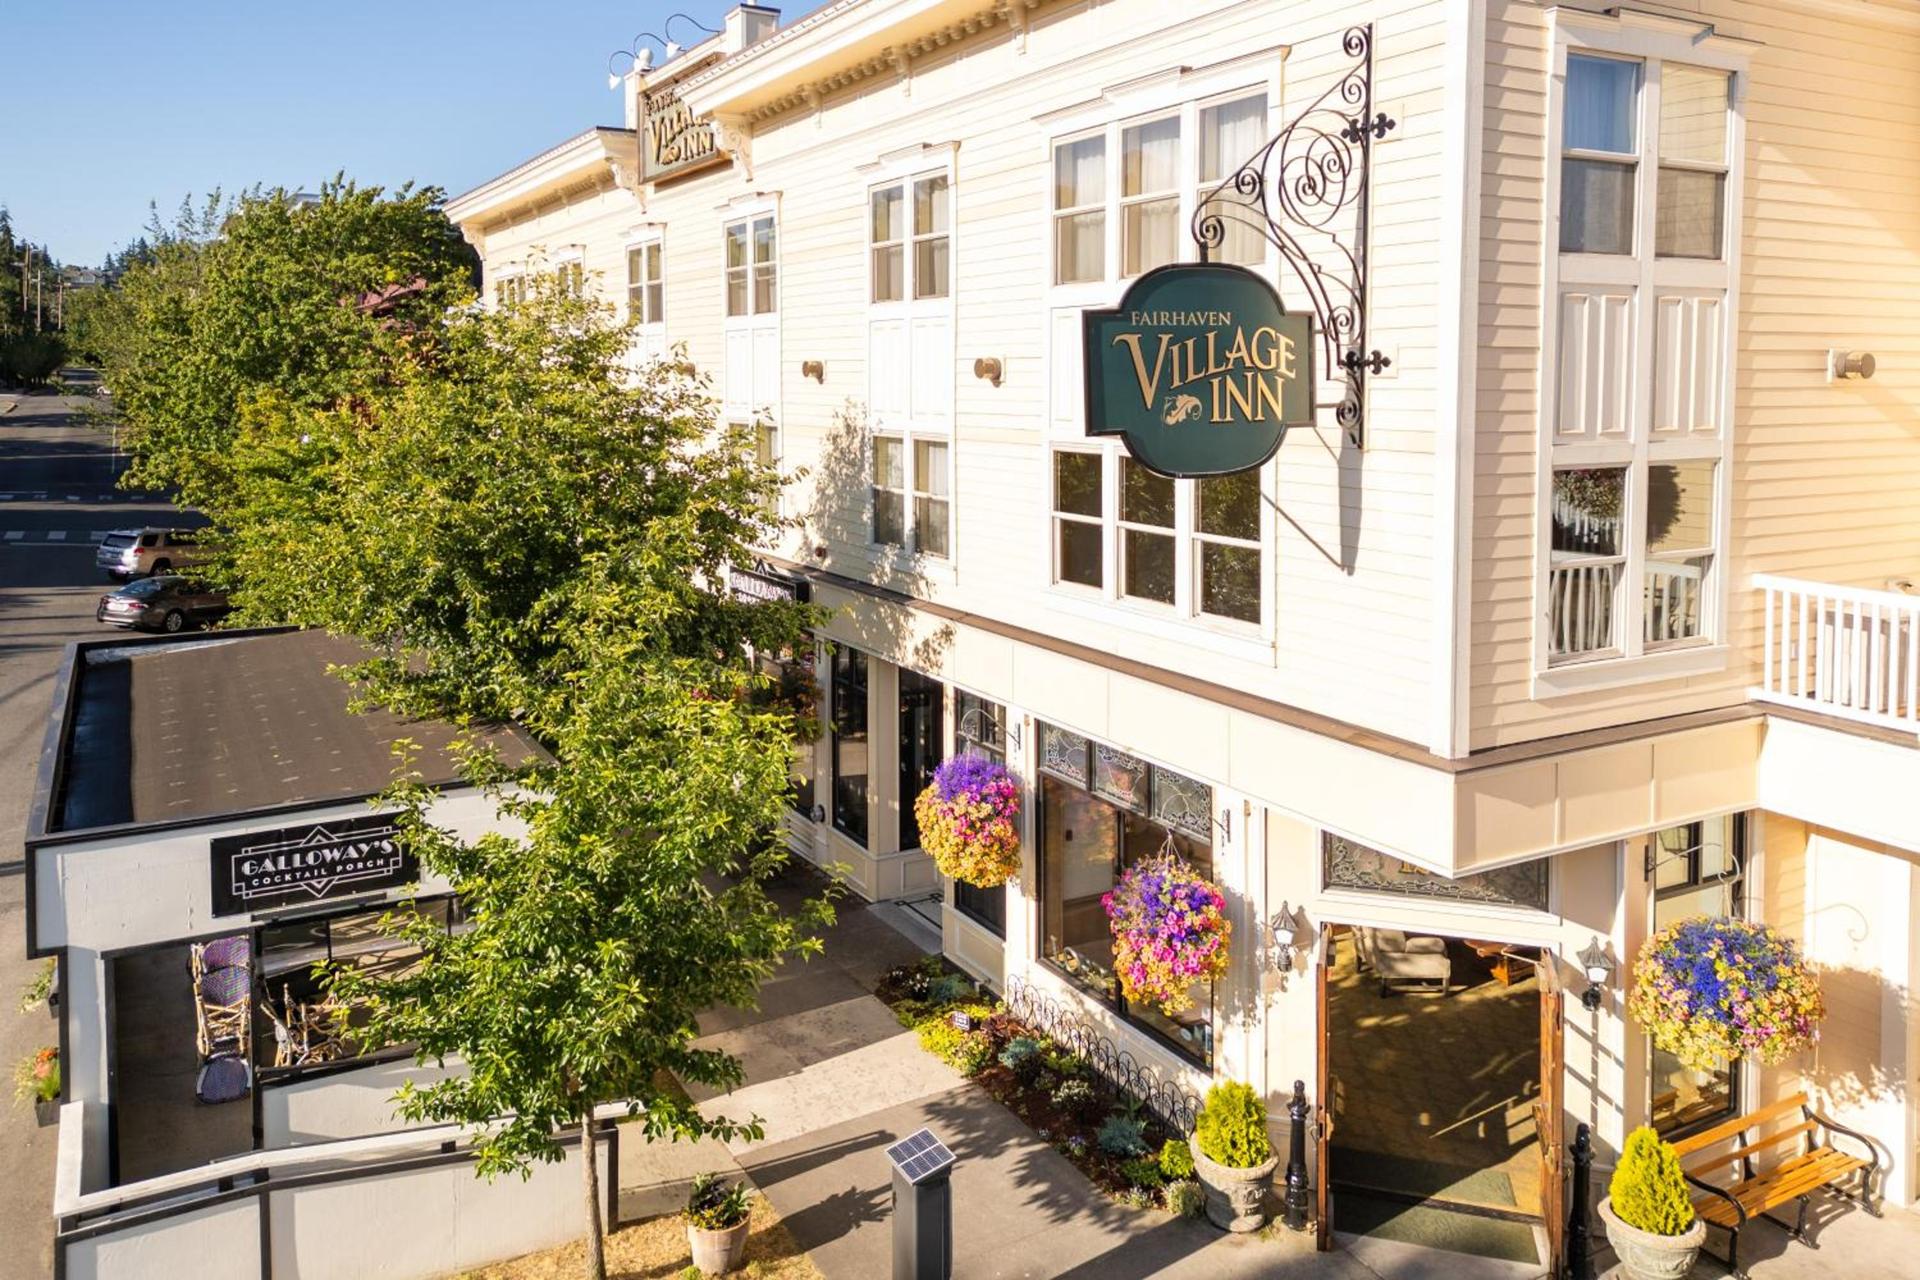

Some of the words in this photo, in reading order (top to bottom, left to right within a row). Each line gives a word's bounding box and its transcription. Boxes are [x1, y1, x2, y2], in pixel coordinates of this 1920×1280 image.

[644, 104, 710, 166] VILLA
[681, 131, 714, 161] INN
[1131, 311, 1231, 326] FAIRHAVEN
[1112, 325, 1297, 411] VILLAGE
[1209, 371, 1285, 425] INN
[241, 839, 394, 876] GALLOWAY'S
[252, 868, 327, 886] COCKTAIL
[336, 858, 385, 873] PORCH
